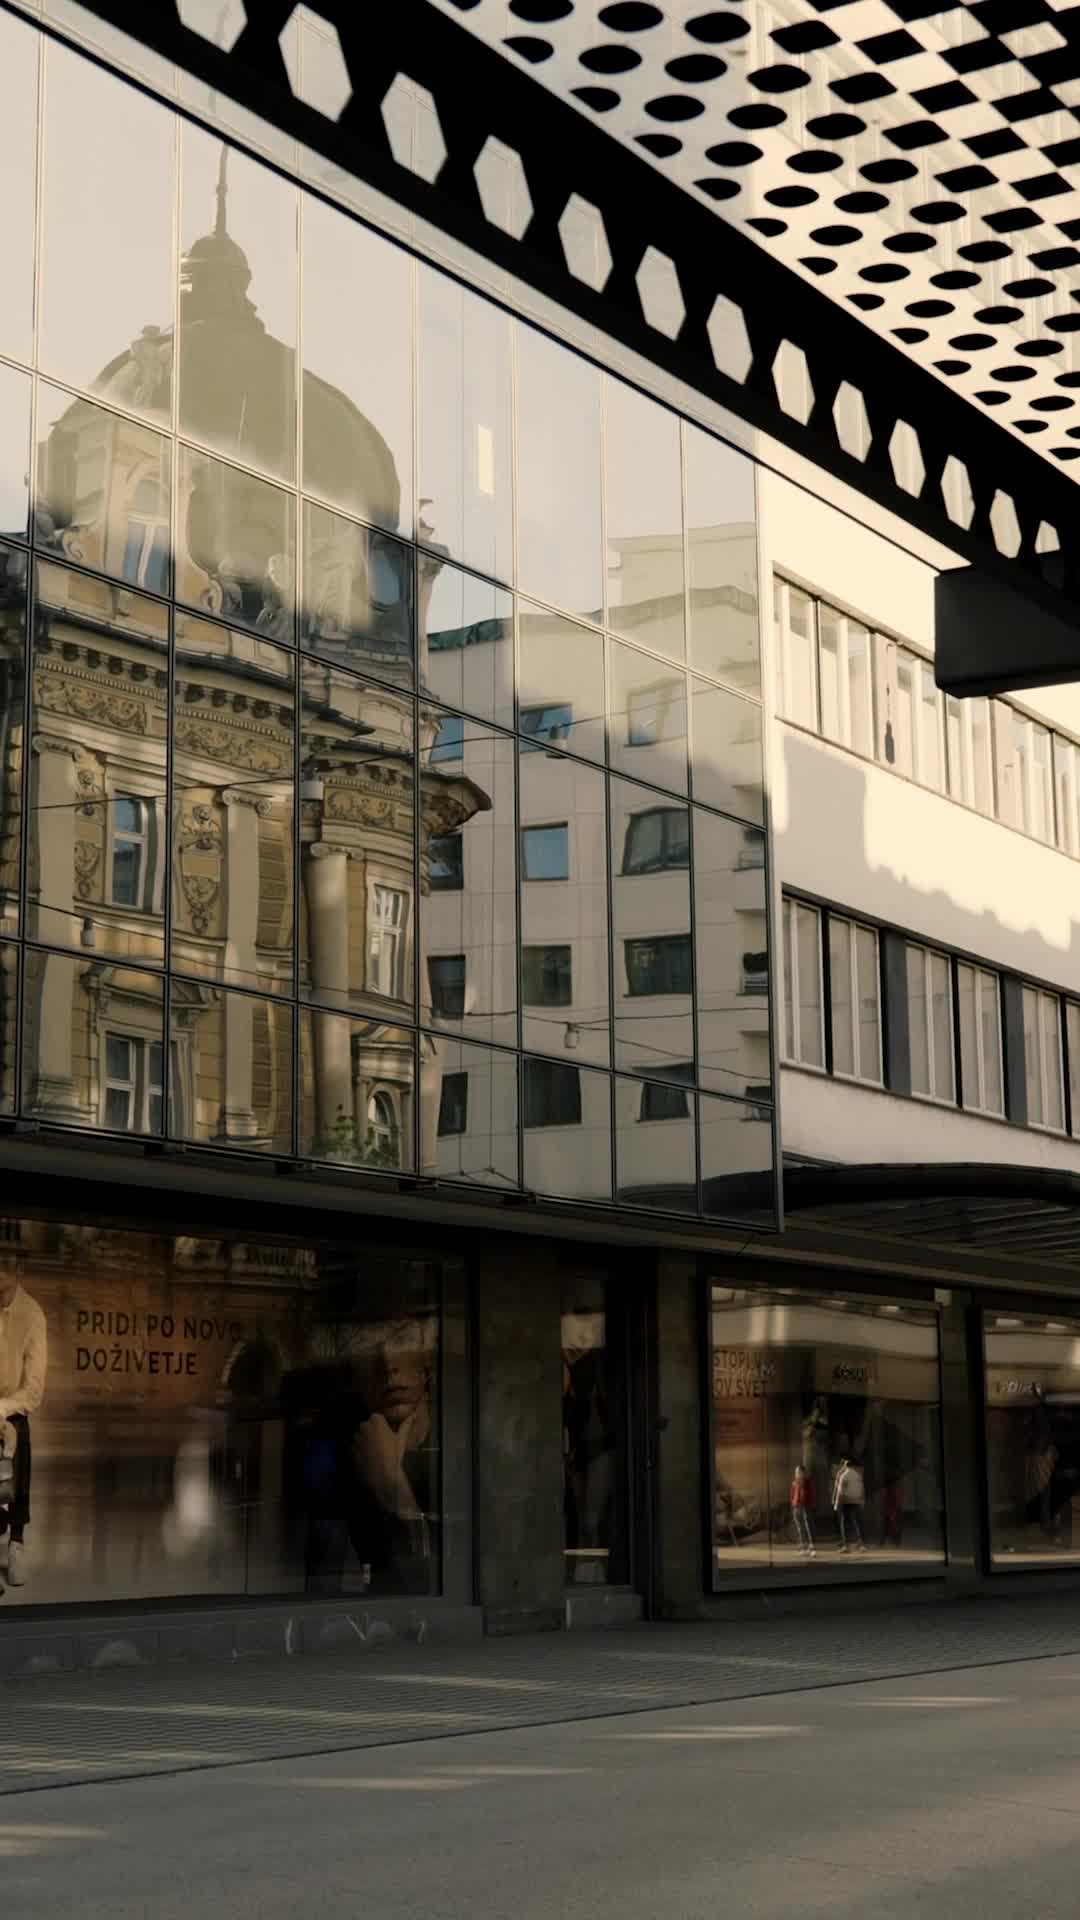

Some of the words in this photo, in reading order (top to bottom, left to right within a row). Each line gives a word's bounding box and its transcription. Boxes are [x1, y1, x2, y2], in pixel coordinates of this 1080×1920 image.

[76, 1310, 137, 1336] PRIDI
[147, 1315, 175, 1338] PO
[76, 1344, 198, 1375] DOŽIVETJE
[713, 1350, 751, 1369] STOPI
[712, 1378, 733, 1397] OV
